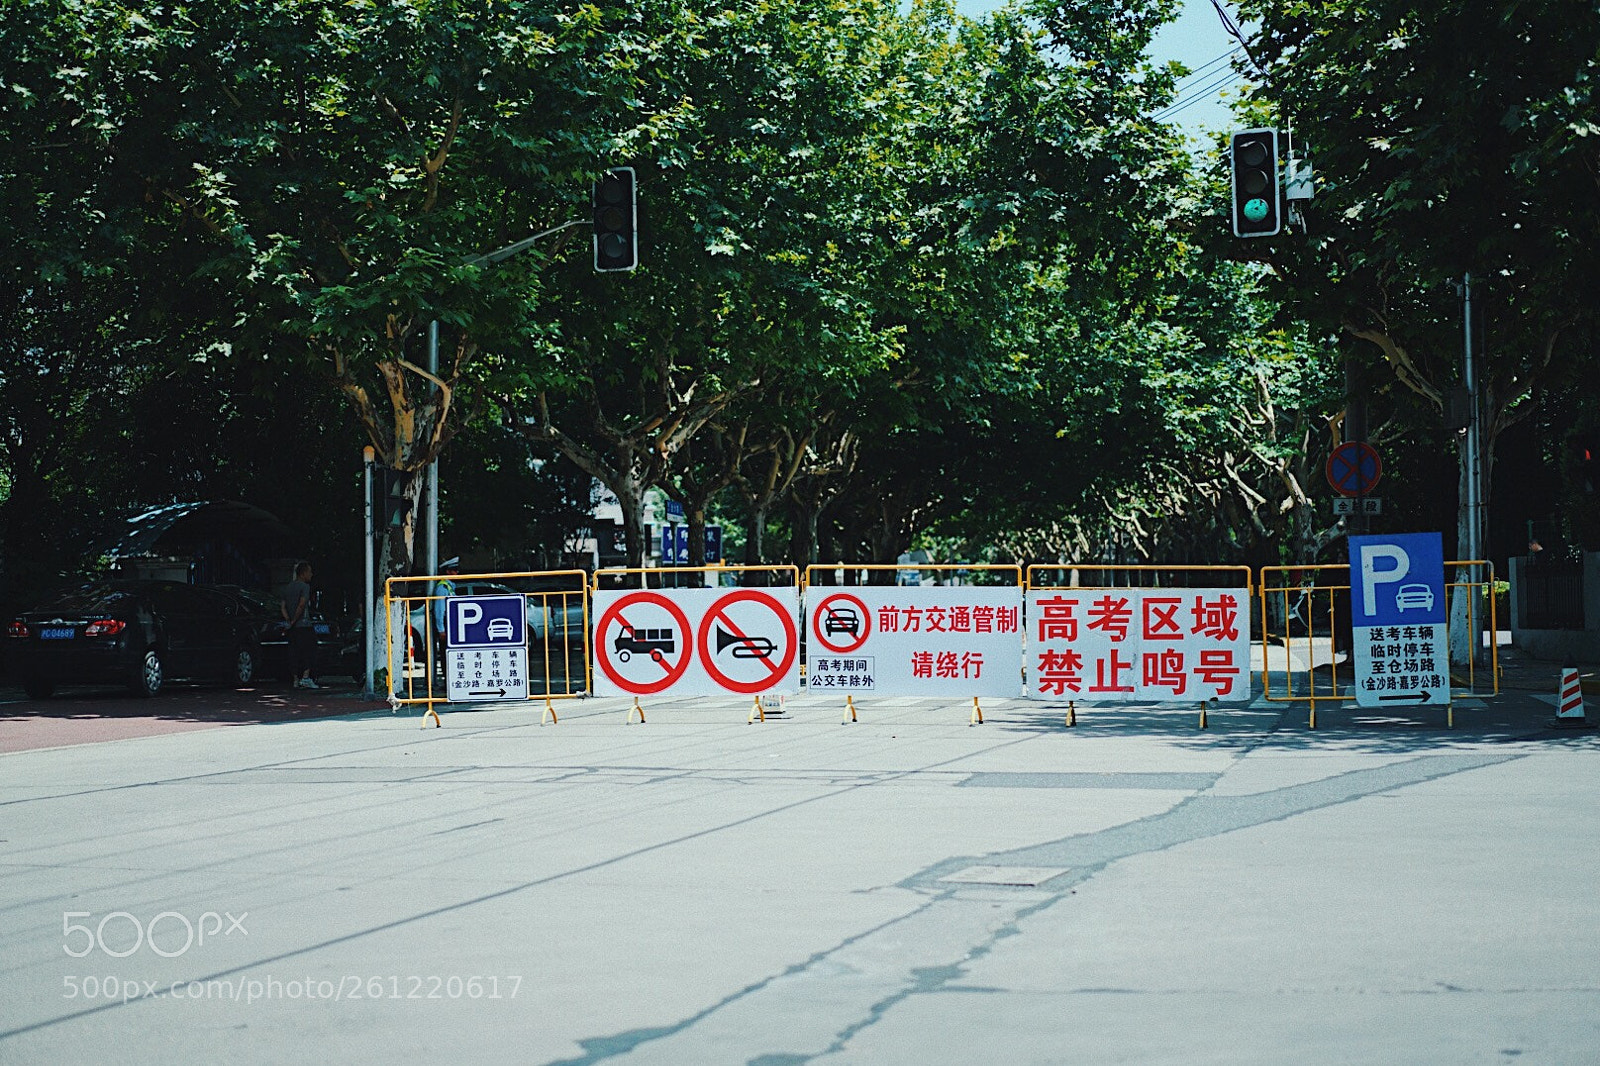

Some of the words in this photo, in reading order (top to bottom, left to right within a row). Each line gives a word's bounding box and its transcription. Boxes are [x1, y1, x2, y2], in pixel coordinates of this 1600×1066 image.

[1338, 501, 1377, 512] 全段
[1360, 544, 1410, 617] P
[457, 602, 483, 643] P
[878, 605, 1018, 634] 前方交通管制
[1036, 595, 1240, 643] 高考区域
[1369, 626, 1434, 641] 送考车辆
[1370, 642, 1435, 658] 临时停车
[456, 660, 518, 669] 临时停车
[818, 659, 867, 671] 高考期间
[911, 651, 984, 679] 请绕行
[1371, 658, 1435, 674] 至仓场路
[811, 674, 874, 687] 公交车除外
[1037, 649, 1240, 697] 禁止鸣号
